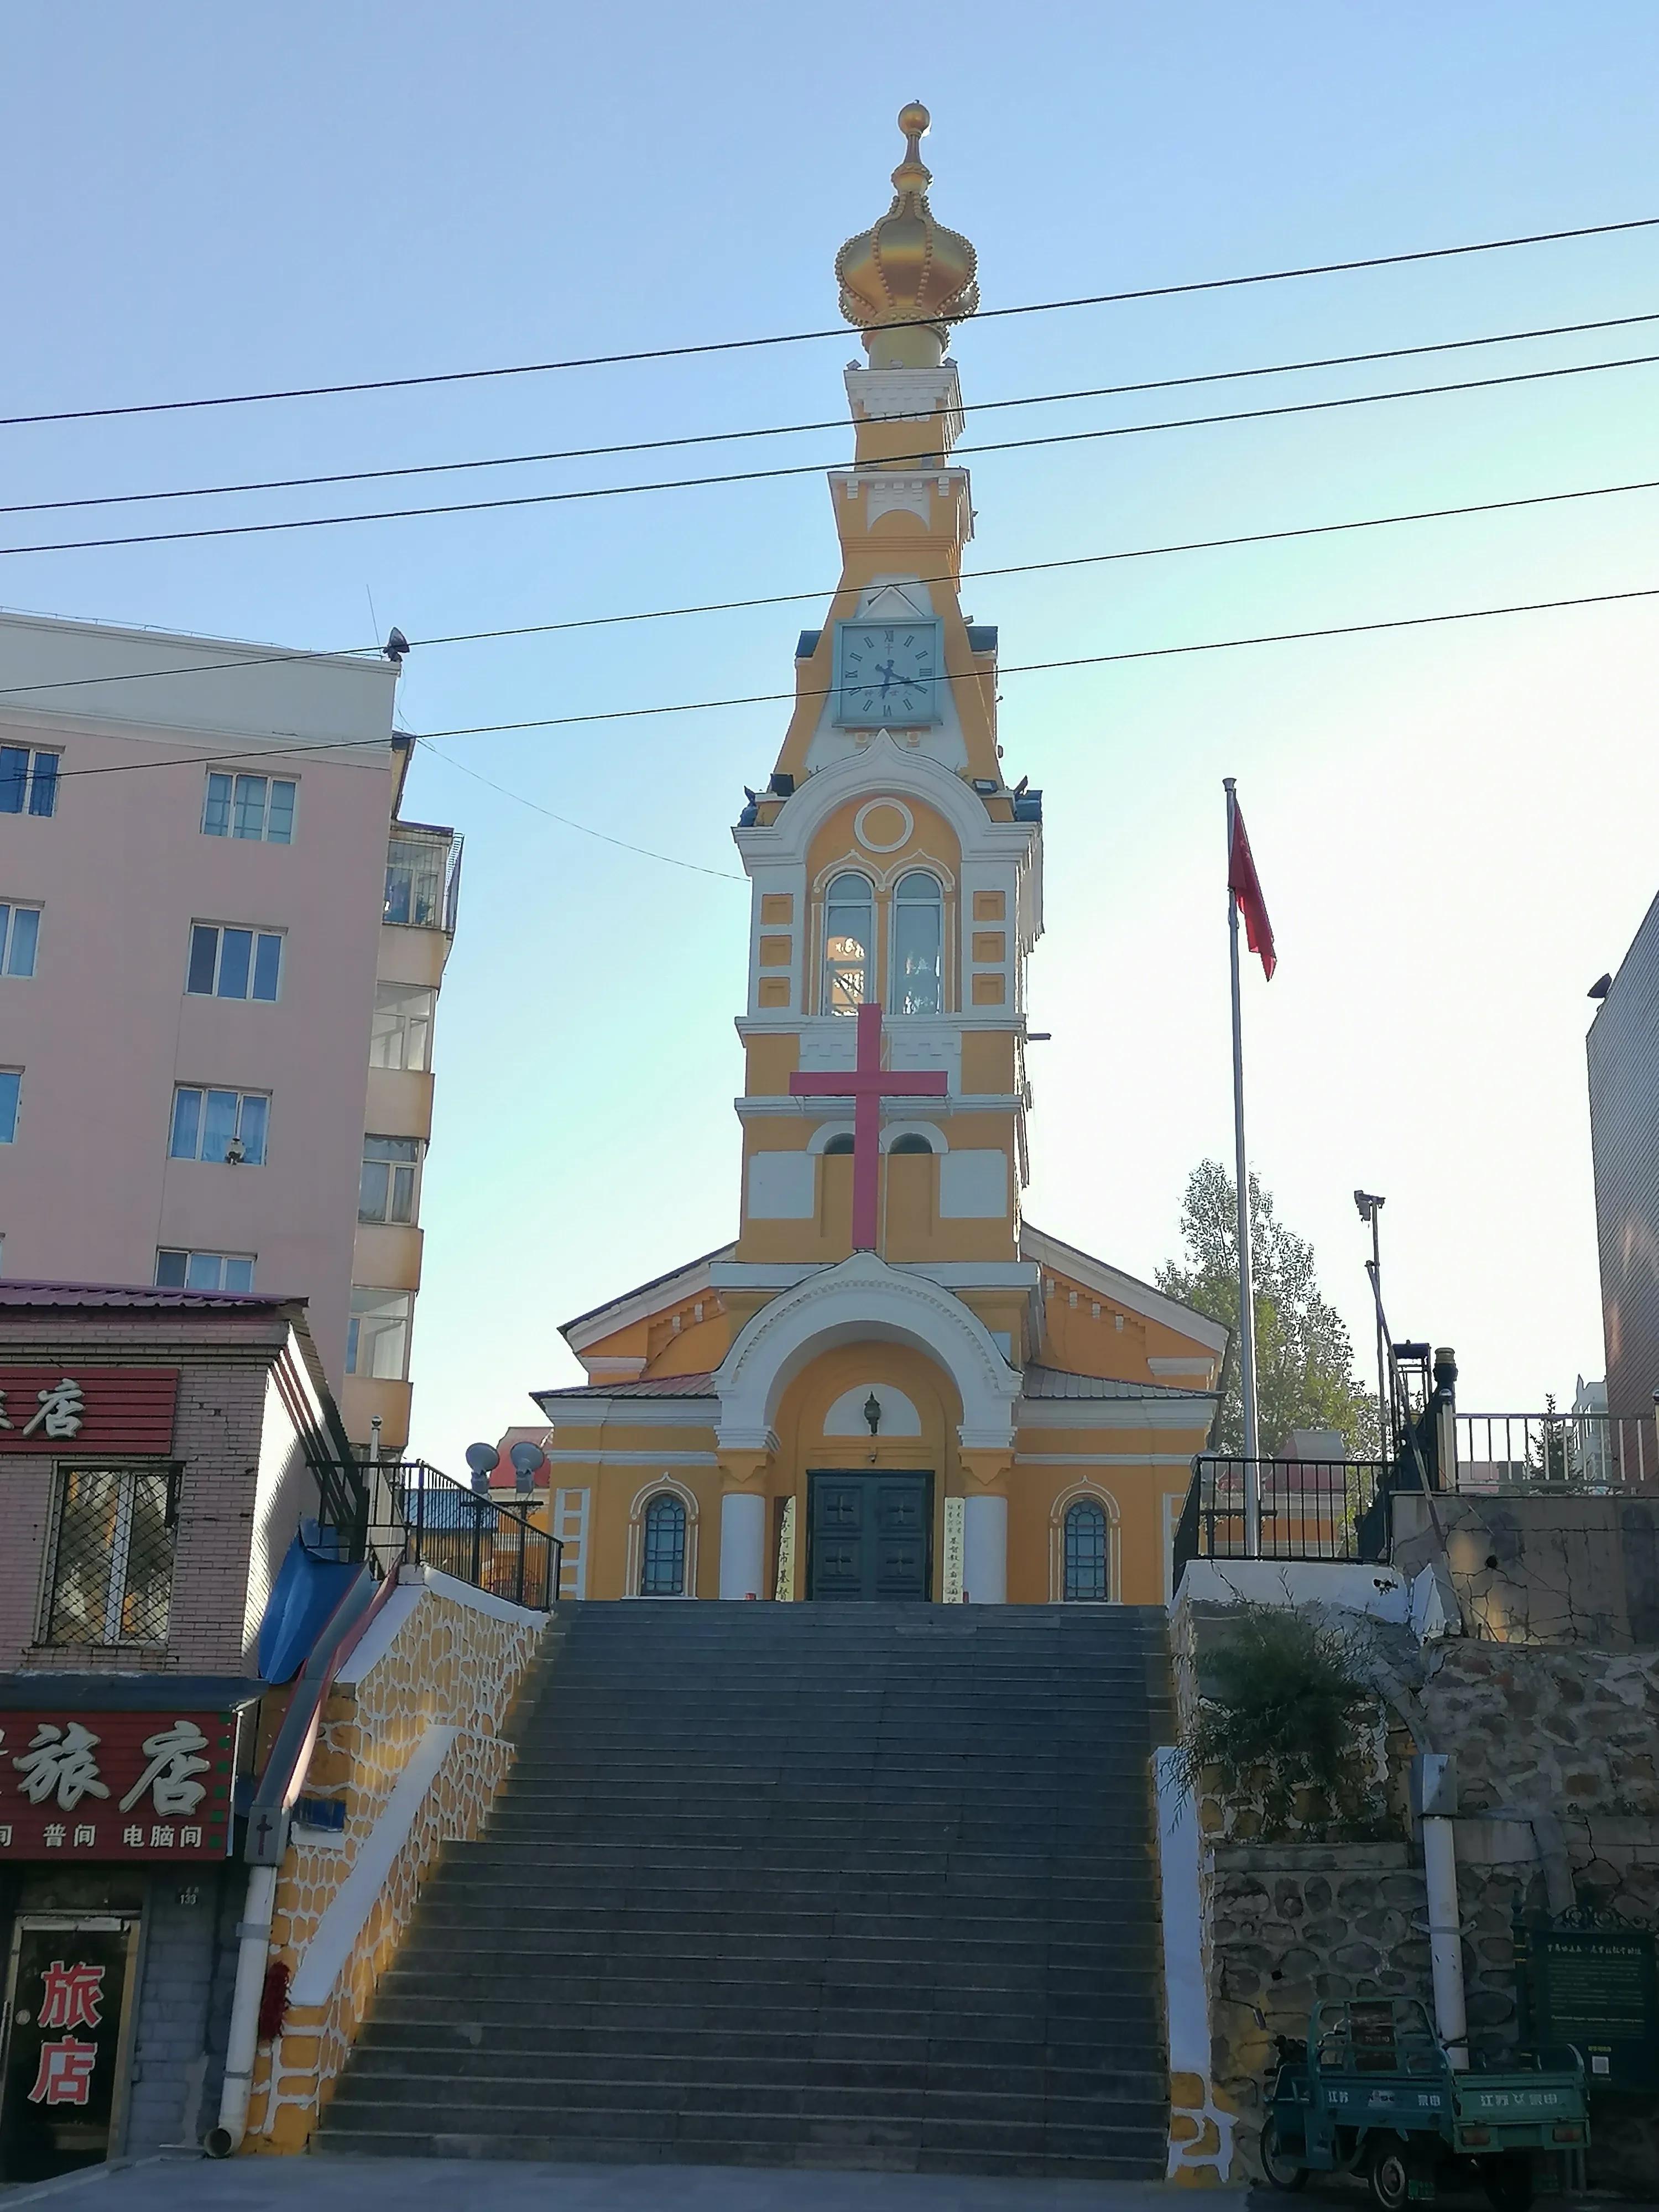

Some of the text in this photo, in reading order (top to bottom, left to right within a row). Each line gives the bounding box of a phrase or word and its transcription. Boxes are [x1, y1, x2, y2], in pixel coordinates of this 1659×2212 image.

[0, 1720, 211, 1817] 旅店
[43, 1824, 96, 1848] 普间
[123, 1824, 202, 1848] 电脑间
[27, 1960, 106, 2105] 旅店
[1328, 2090, 1349, 2104] 江苏
[1480, 2094, 1510, 2107] 江苏
